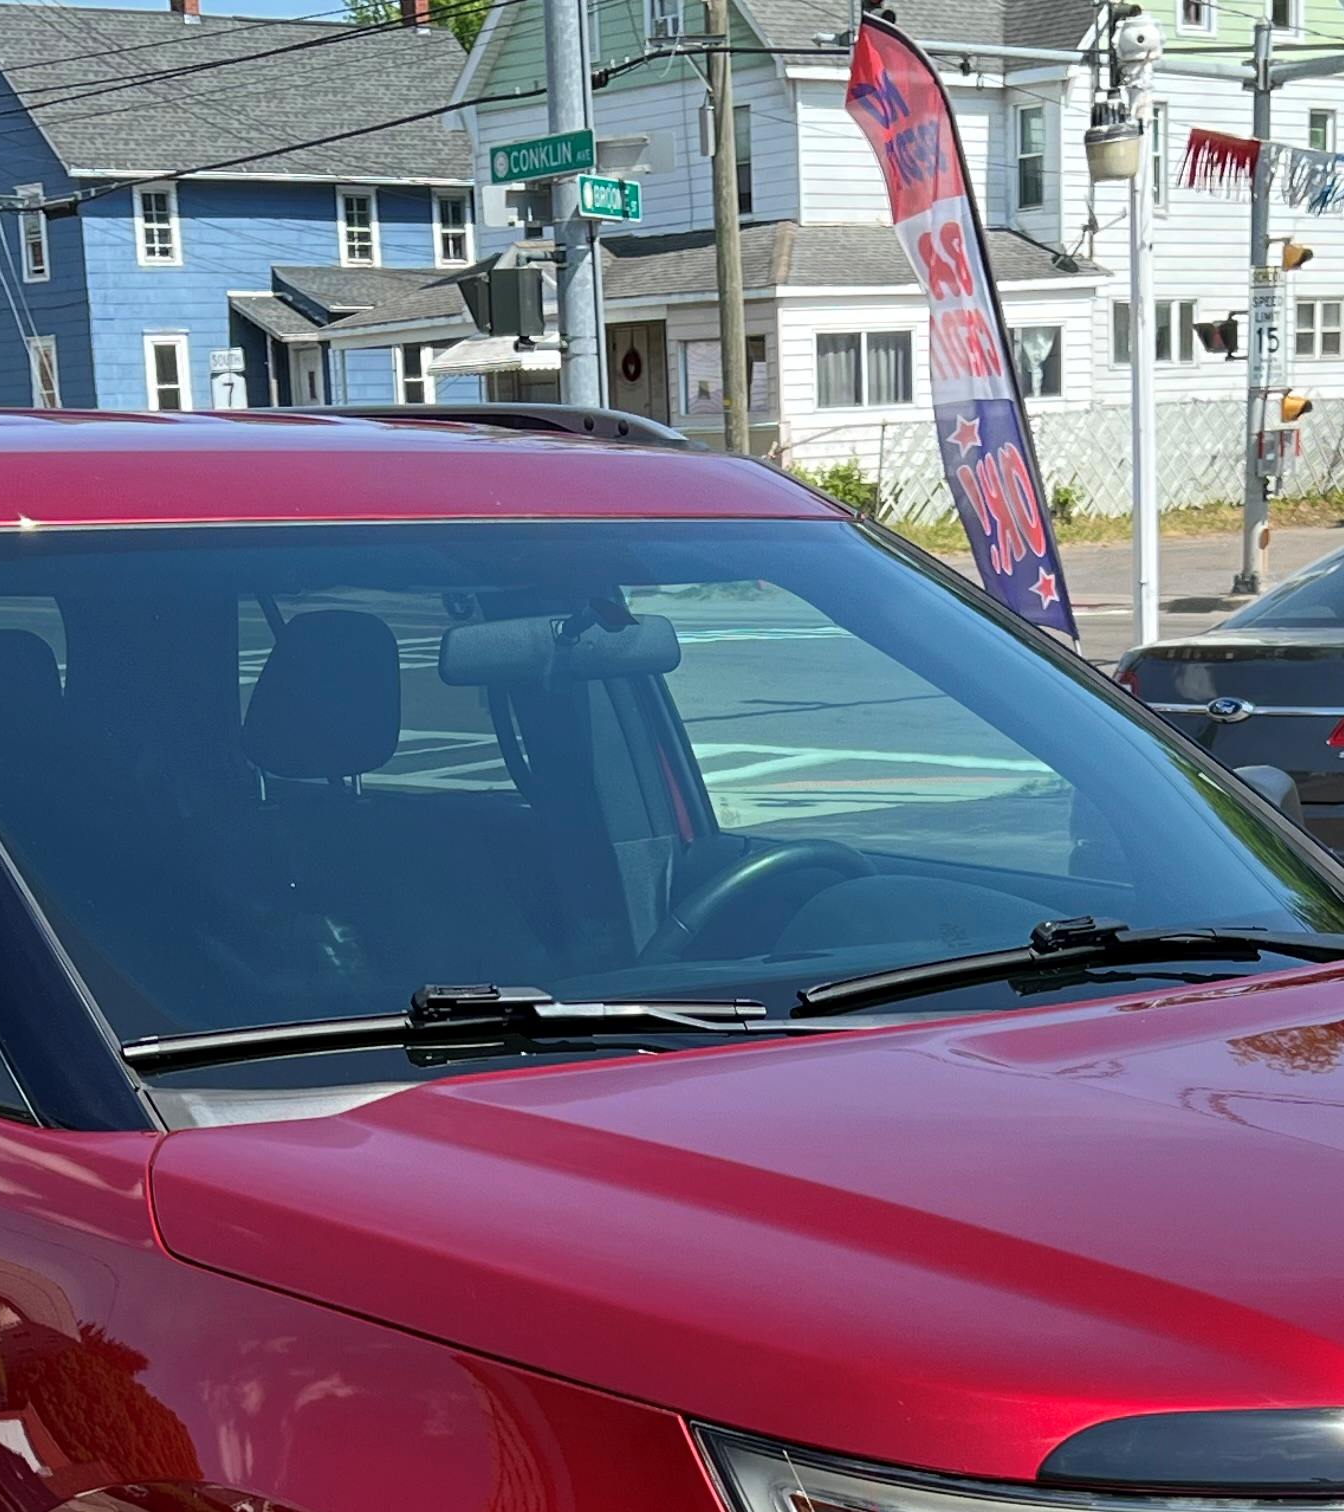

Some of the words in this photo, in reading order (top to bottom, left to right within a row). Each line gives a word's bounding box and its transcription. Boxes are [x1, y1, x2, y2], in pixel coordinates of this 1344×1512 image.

[510, 141, 572, 174] CONKLIN
[575, 148, 592, 163] AVE
[1252, 296, 1283, 308] SPEED
[1255, 311, 1281, 324] LIMIT
[1256, 327, 1280, 354] 15
[212, 353, 242, 368] SOUTH
[222, 382, 234, 407] 7
